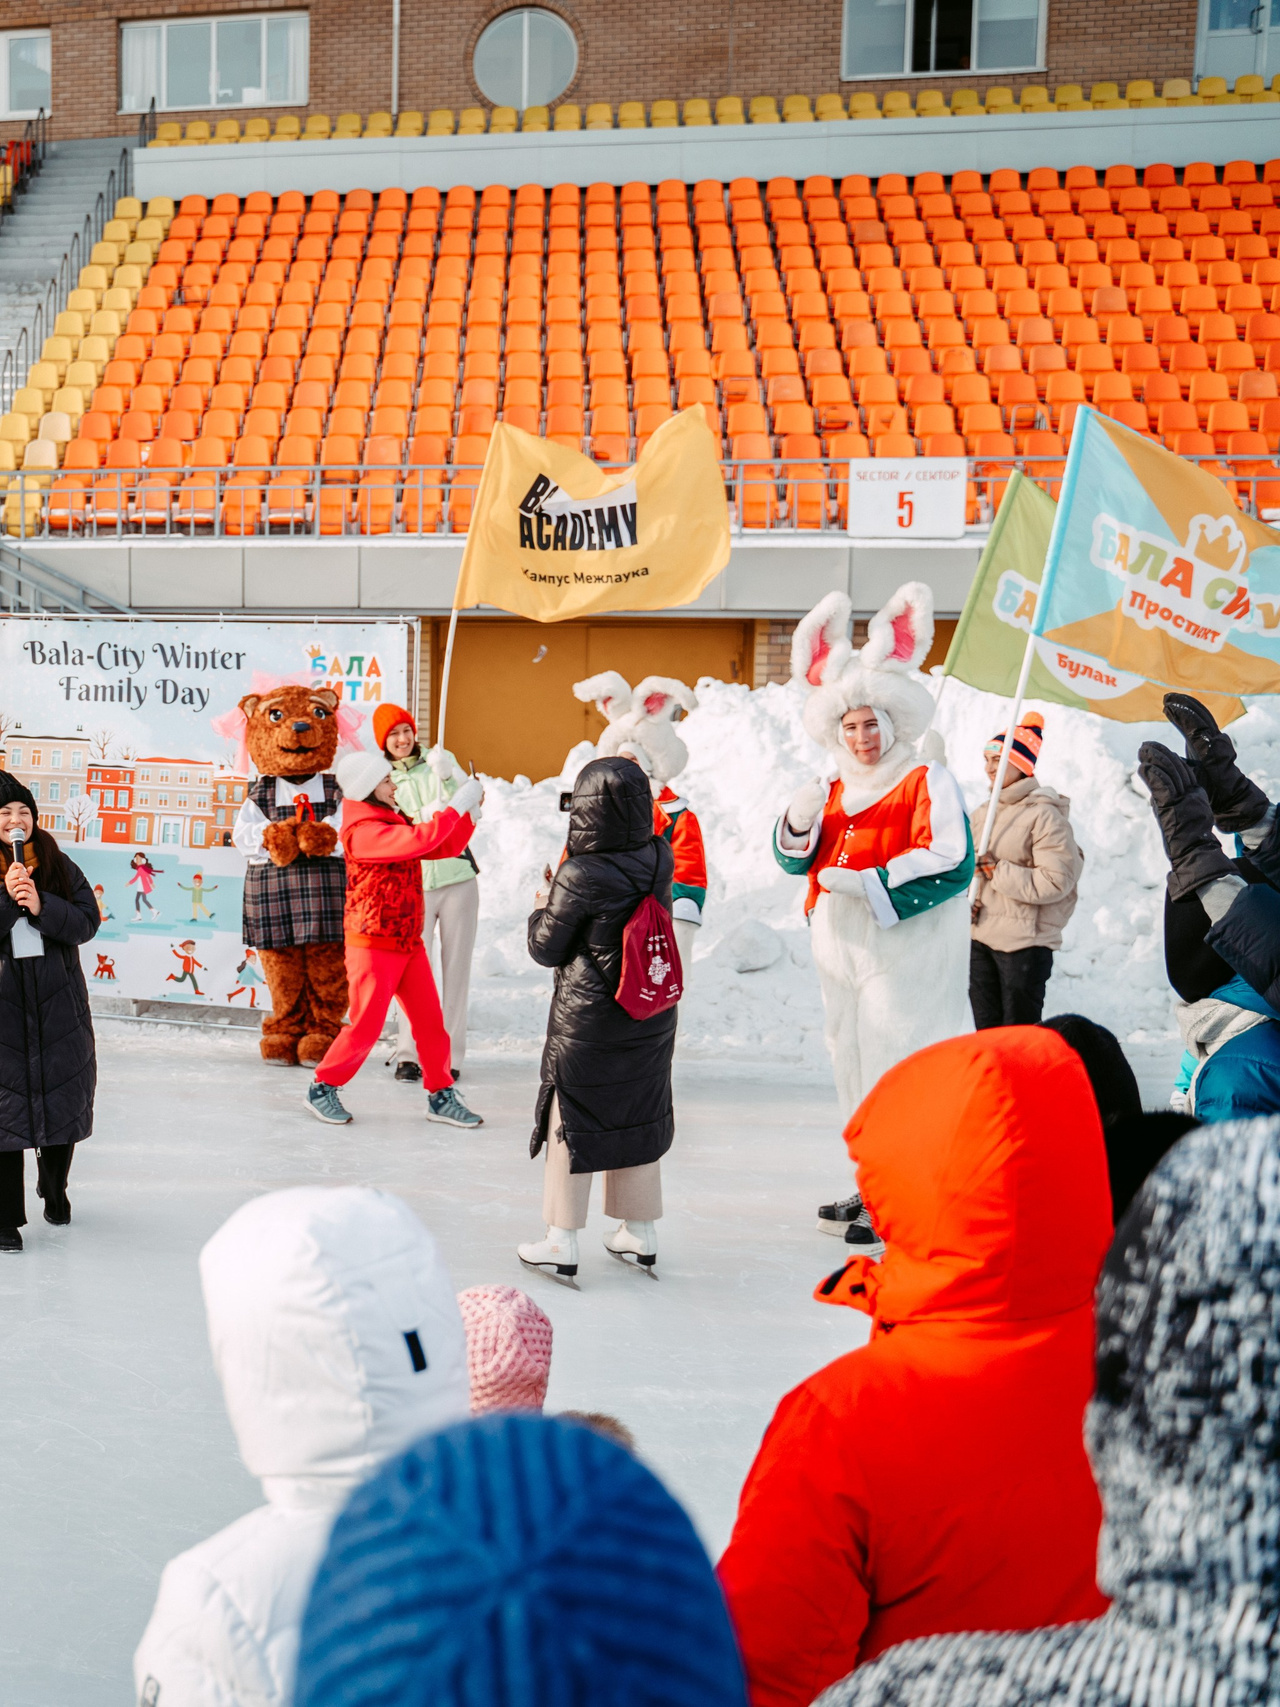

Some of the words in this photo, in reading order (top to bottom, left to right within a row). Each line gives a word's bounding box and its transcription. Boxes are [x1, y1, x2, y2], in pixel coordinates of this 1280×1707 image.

[856, 470, 899, 481] SECTOR
[519, 502, 638, 551] ACADEMY
[897, 491, 914, 528] 5
[574, 567, 650, 585] Межлаука
[1099, 523, 1195, 599] БАЛА
[23, 640, 146, 675] Bala-City
[151, 642, 247, 672] Winter
[311, 656, 382, 678] БАЛА
[1056, 653, 1118, 688] Булак
[58, 676, 148, 710] Family
[154, 678, 210, 713] Day
